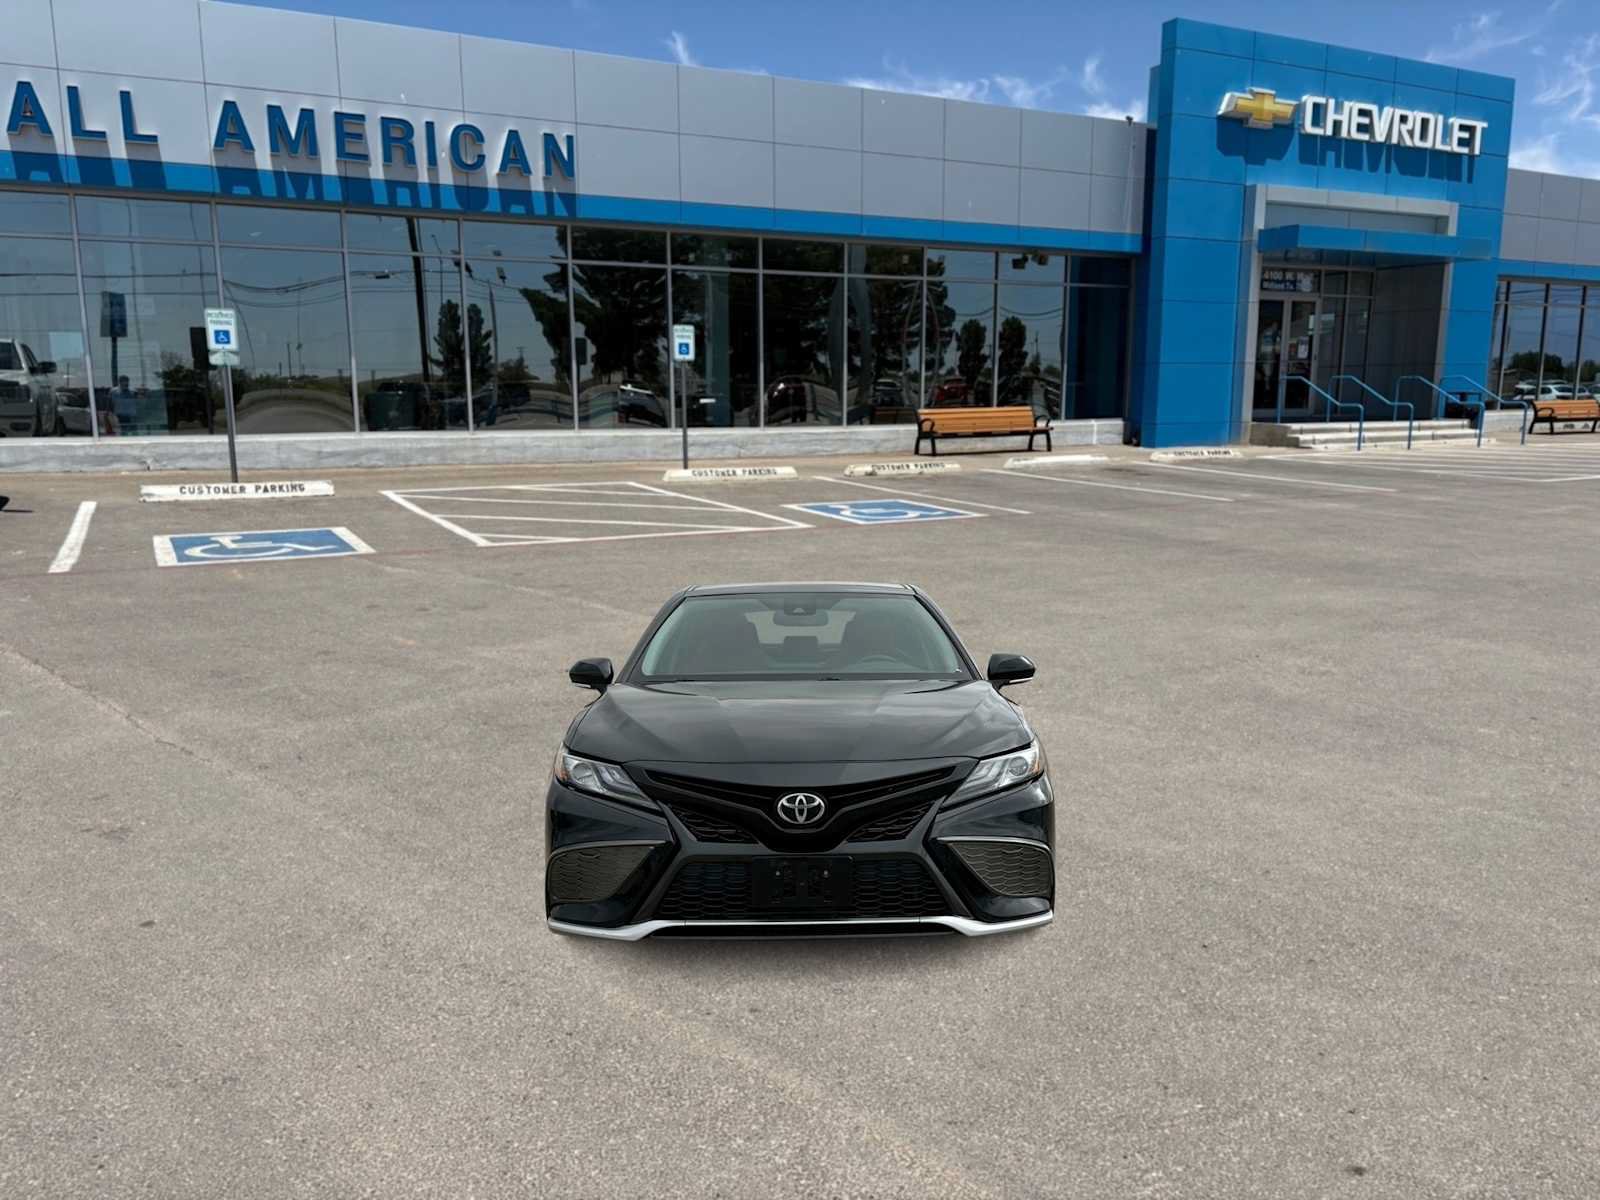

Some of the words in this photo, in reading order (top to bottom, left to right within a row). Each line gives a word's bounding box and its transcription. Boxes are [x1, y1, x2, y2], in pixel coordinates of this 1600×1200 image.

[6, 80, 159, 144] ALL
[212, 99, 577, 181] AMERICAN
[1302, 94, 1488, 155] CHEVROLET
[179, 484, 246, 495] CUSTOMER
[254, 482, 306, 493] PARKING
[691, 469, 737, 477] CUSTOMER
[742, 468, 778, 476] PARKING
